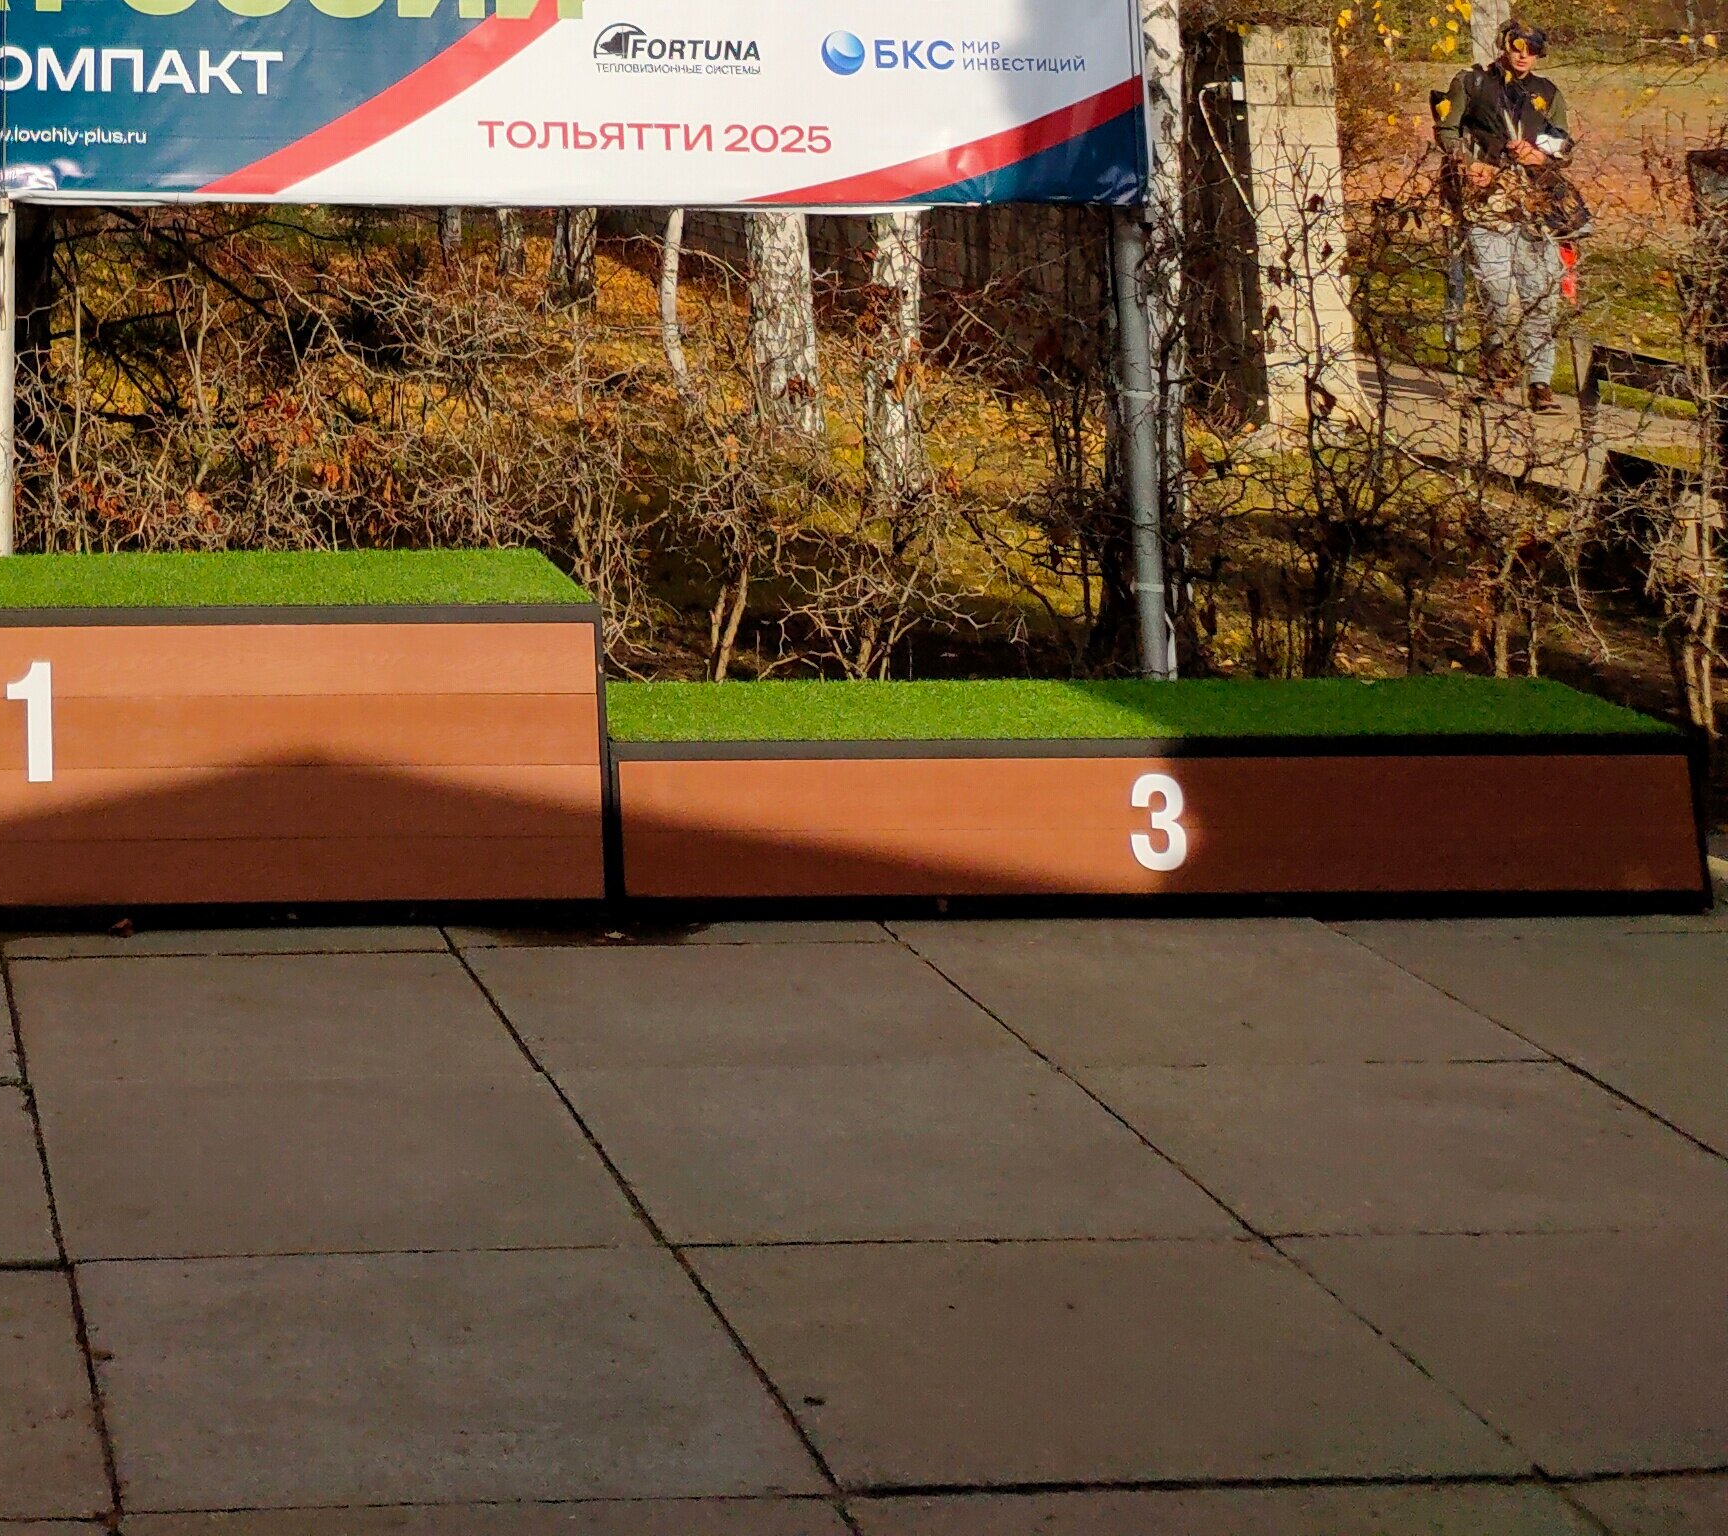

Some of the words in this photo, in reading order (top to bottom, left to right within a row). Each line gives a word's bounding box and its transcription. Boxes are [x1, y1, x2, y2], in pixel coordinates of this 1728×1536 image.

[631, 38, 761, 61] FORTUNA
[874, 39, 956, 70] БКС
[962, 40, 1001, 55] МИР
[596, 62, 702, 74] ТЕПЛОВИЗИОННЫЕ
[705, 64, 761, 76] СИСТЕМЫ
[963, 55, 1086, 74] ИНВЕСТИЦИЙ
[477, 120, 713, 152] ТОЛЬЯТТИ
[723, 124, 833, 154] 2025
[6, 660, 54, 783] 1
[1130, 773, 1187, 872] 3
